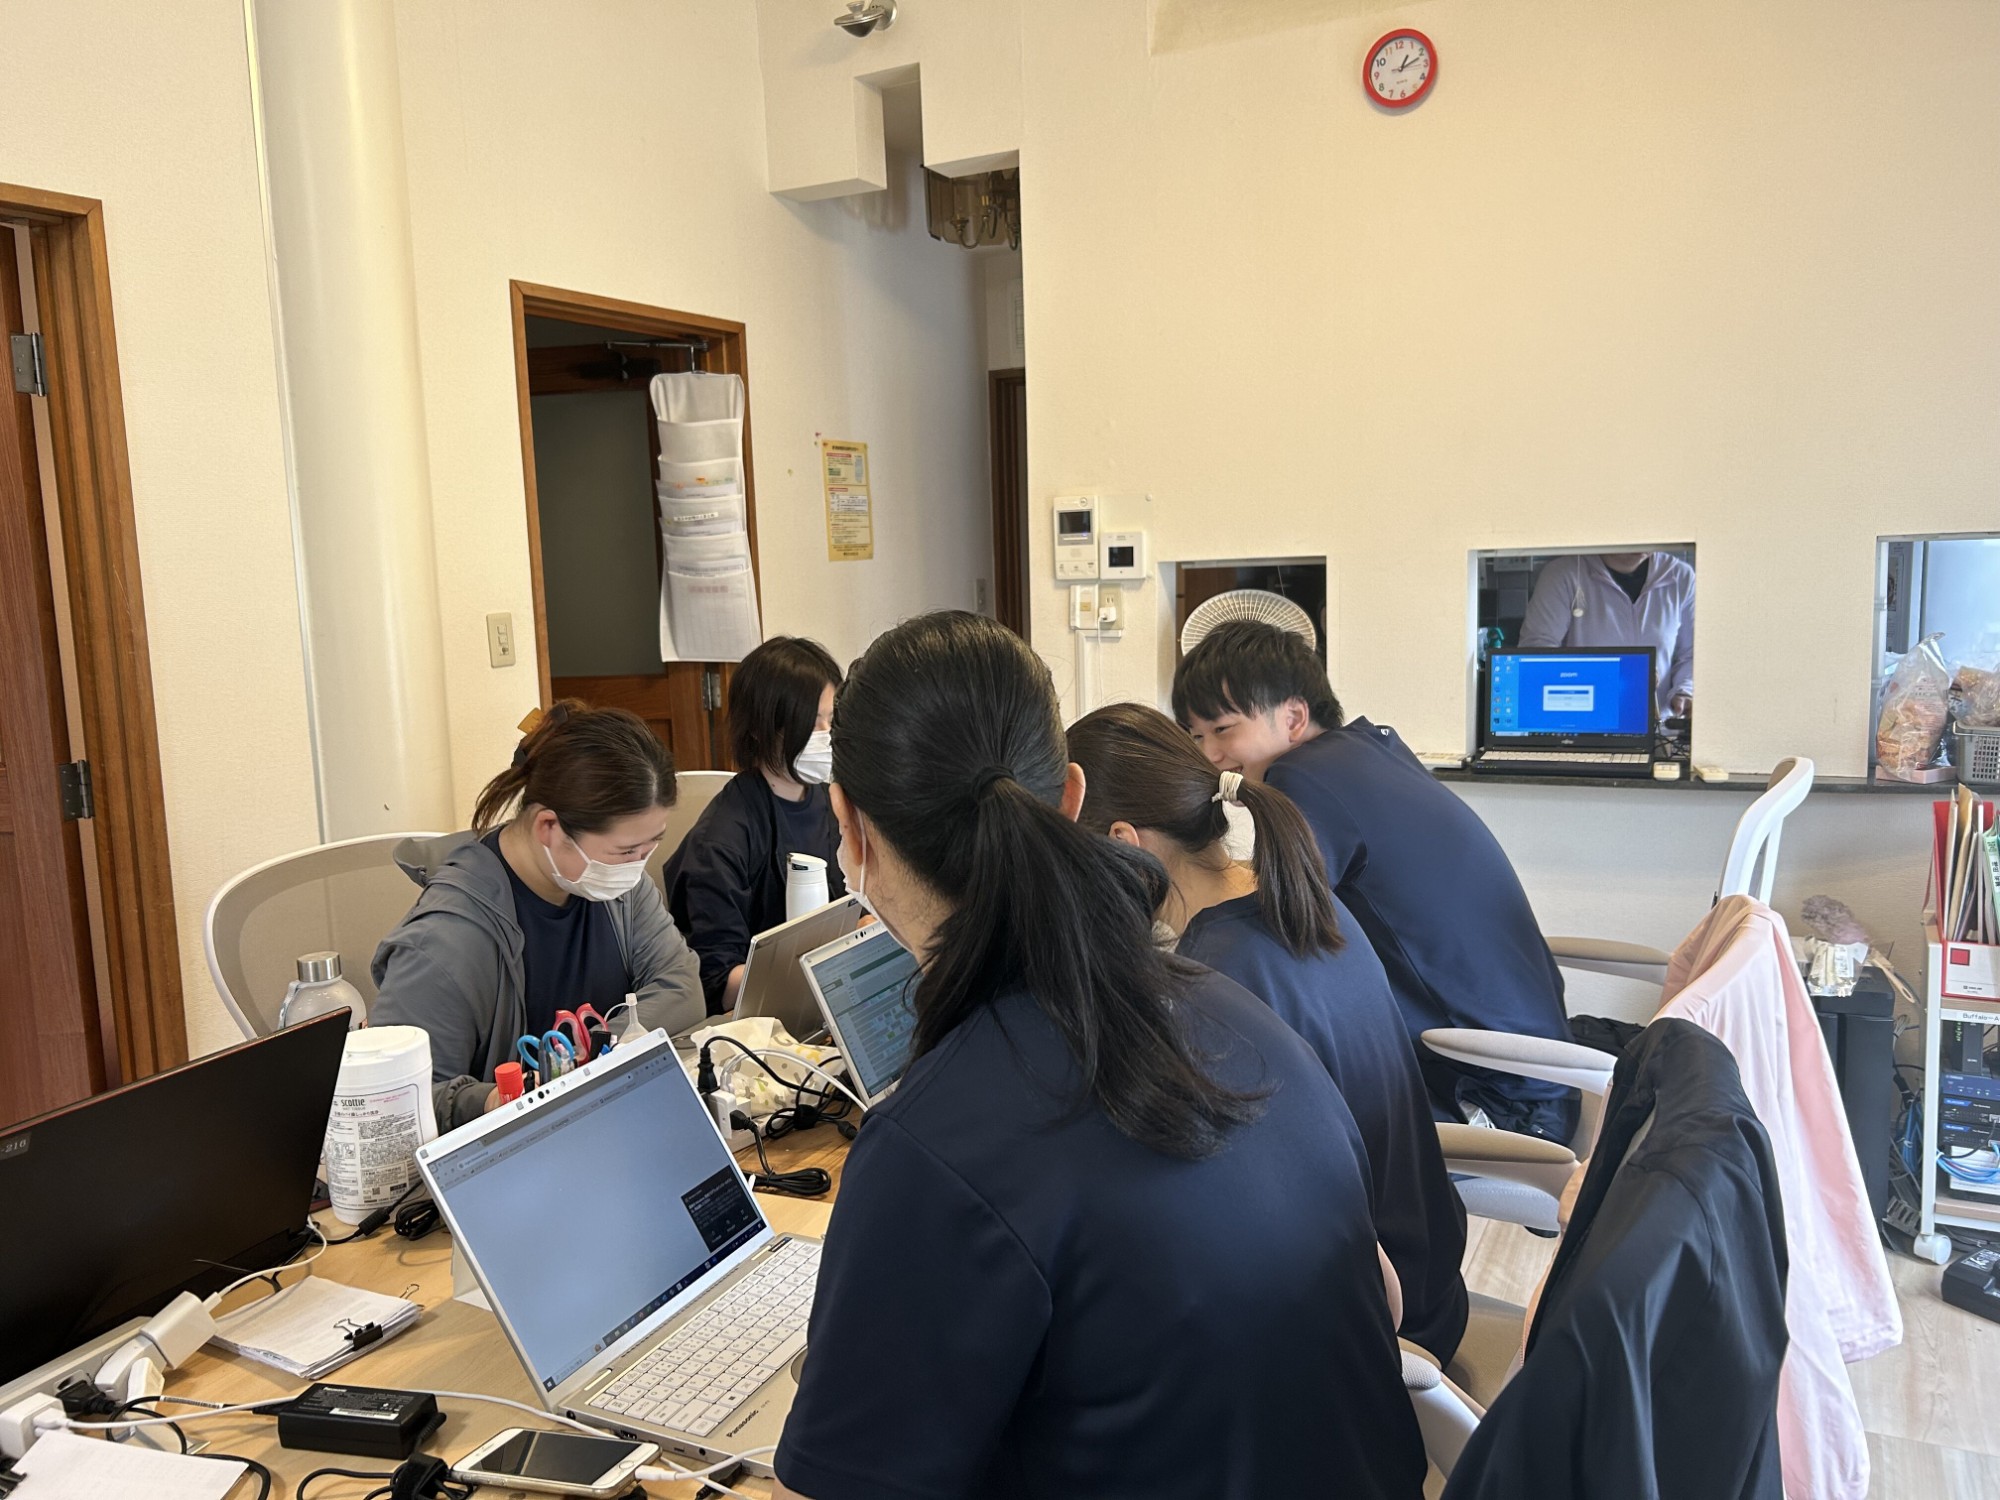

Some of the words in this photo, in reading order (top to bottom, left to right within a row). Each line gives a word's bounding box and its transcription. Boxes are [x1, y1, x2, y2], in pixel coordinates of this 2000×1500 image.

[1395, 40, 1404, 50] 12
[1385, 47, 1393, 57] 11
[1376, 57, 1386, 68] 10
[1374, 71, 1380, 80] 9
[1420, 72, 1426, 80] 4
[1379, 82, 1385, 92] 8
[1400, 89, 1406, 98] 6
[341, 1099, 365, 1107] scottie
